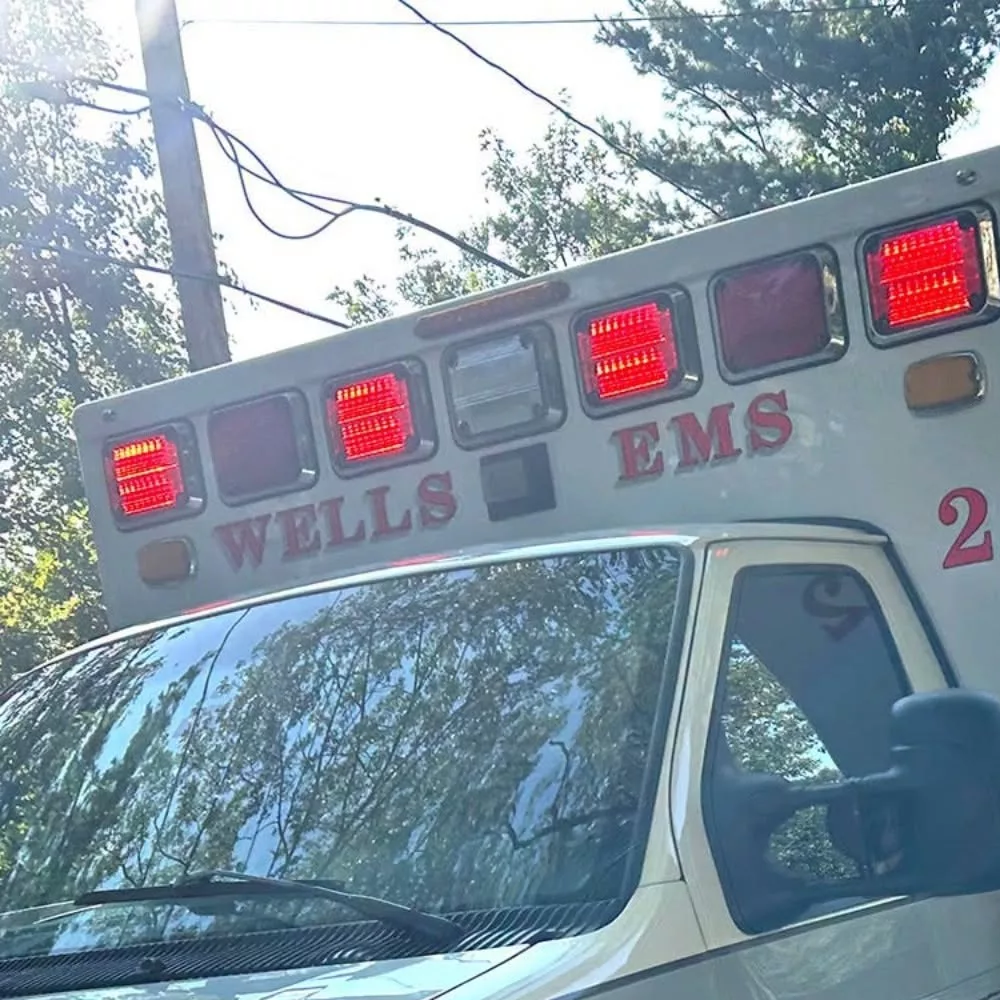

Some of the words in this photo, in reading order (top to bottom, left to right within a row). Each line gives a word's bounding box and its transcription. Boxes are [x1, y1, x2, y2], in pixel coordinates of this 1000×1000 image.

[213, 471, 458, 574] WELLS
[612, 390, 794, 483] EMS
[938, 486, 993, 570] 2
